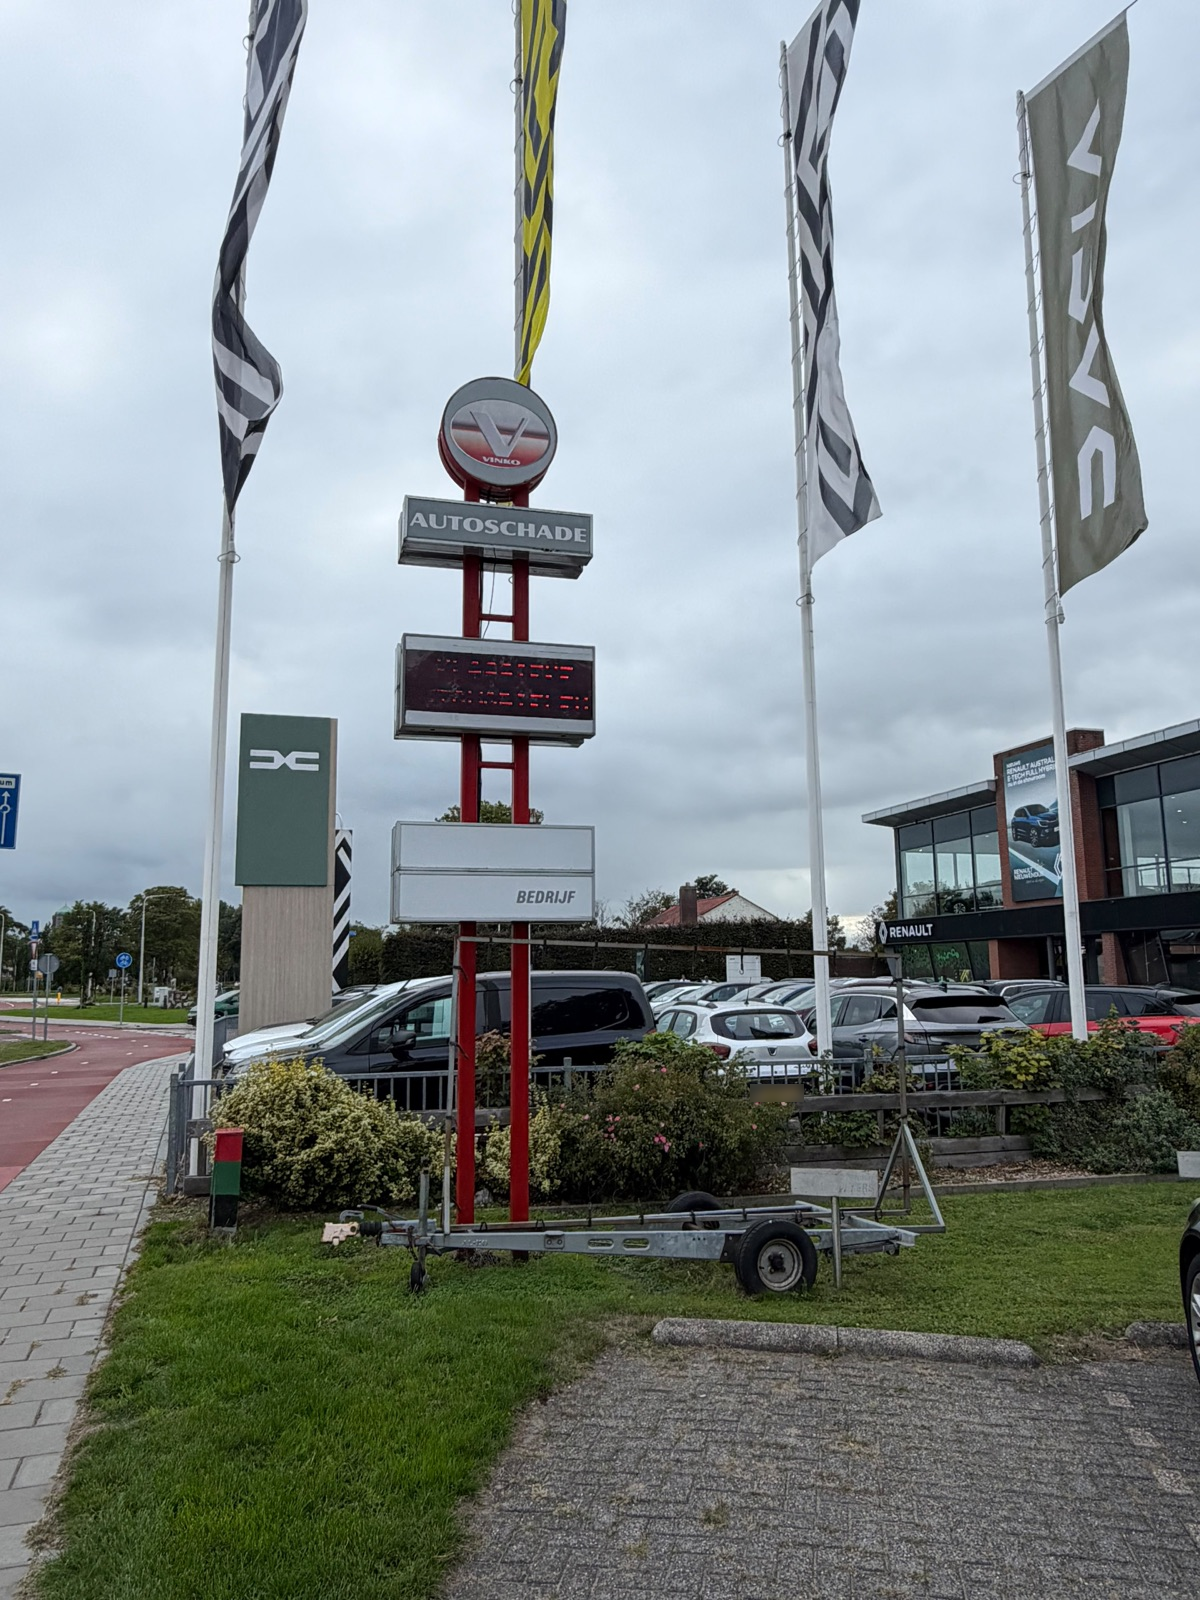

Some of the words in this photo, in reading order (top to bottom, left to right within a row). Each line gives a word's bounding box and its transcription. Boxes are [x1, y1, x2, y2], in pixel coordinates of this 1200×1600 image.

[482, 455, 521, 466] VINKO
[409, 512, 587, 543] AUTOSCHADE
[1006, 763, 1030, 775] RENAULT
[1030, 756, 1056, 769] AUSTRAL
[1007, 772, 1025, 783] E-TECH
[1025, 769, 1038, 777] FULL
[516, 890, 576, 904] BEDRIJF
[889, 923, 933, 938] RENAULT
